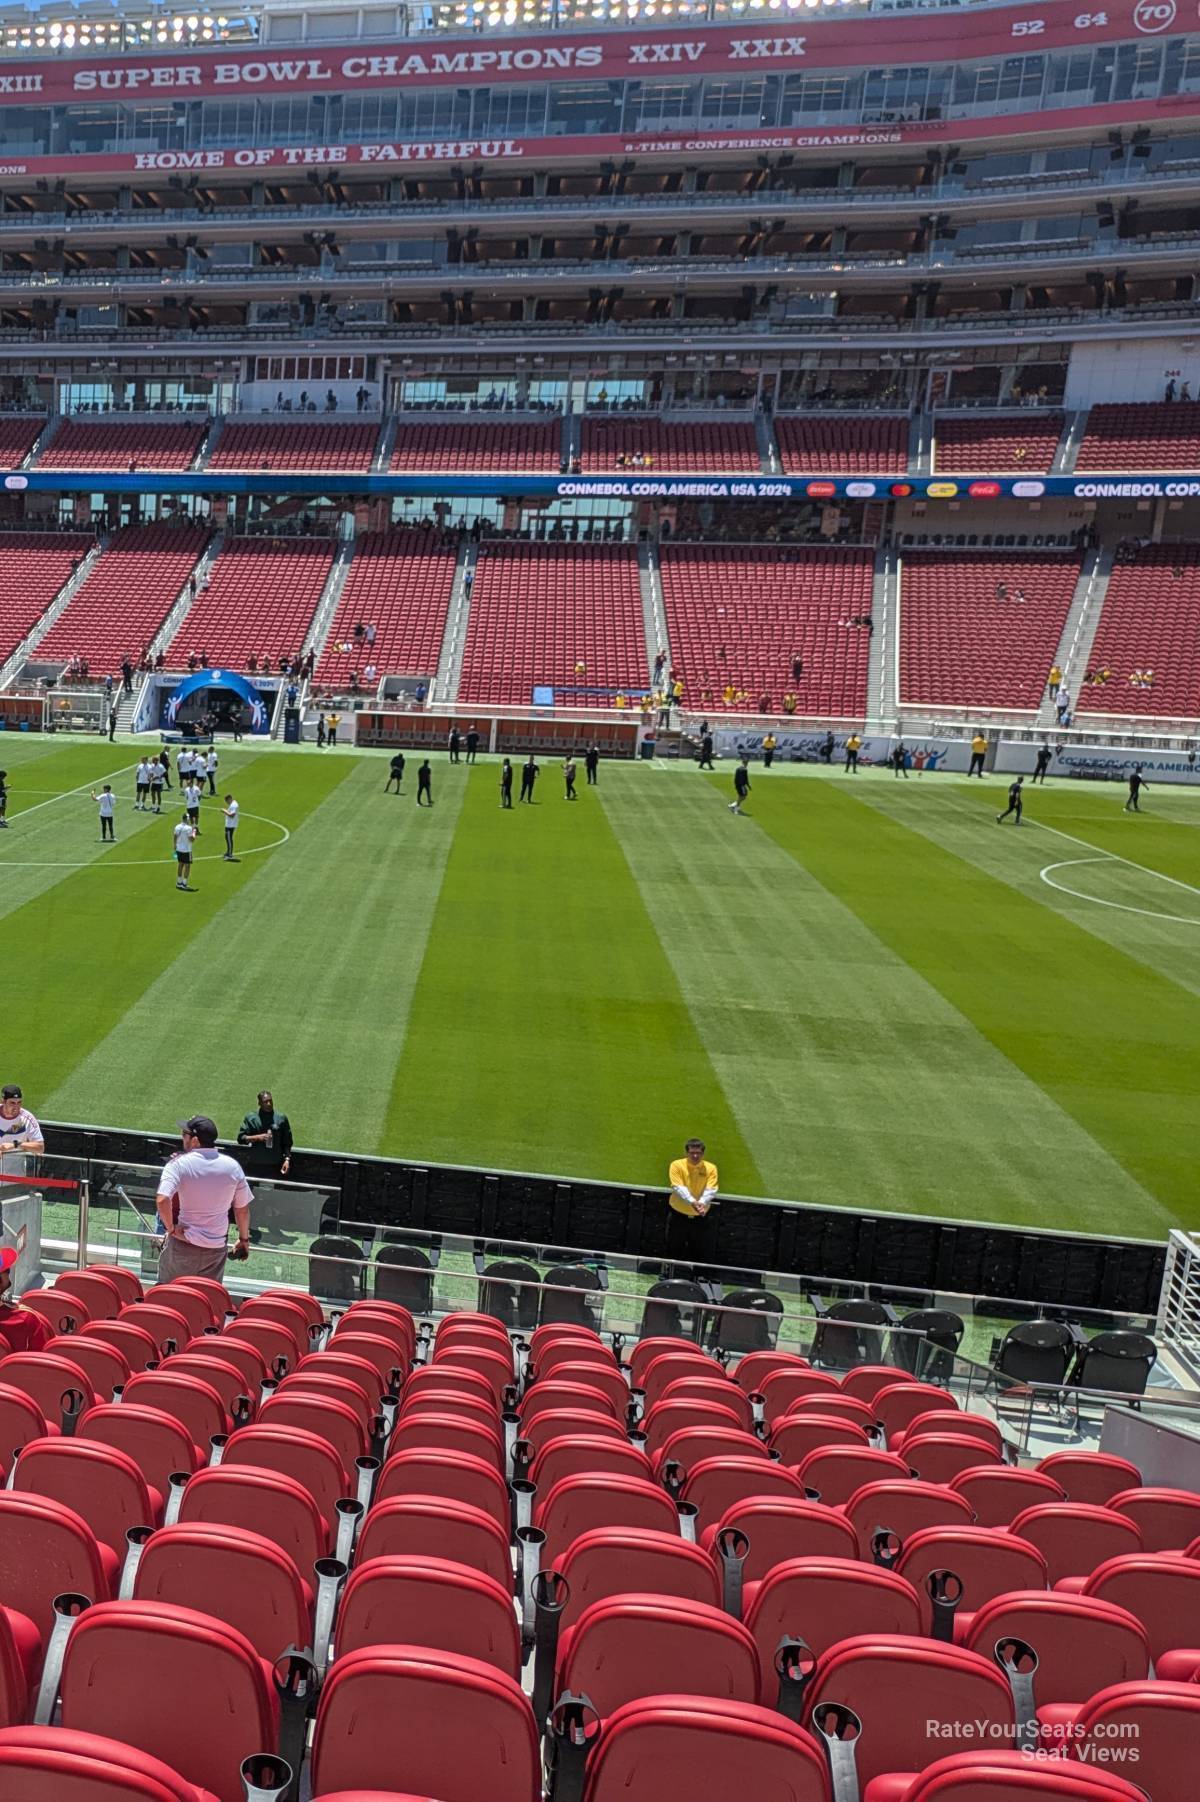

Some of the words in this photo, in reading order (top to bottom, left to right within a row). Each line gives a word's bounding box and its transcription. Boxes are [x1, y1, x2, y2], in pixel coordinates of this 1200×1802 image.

[1074, 12, 1108, 28] 64
[1139, 5, 1171, 20] 70
[1011, 20, 1045, 36] 52
[628, 42, 706, 64] XXIV
[728, 37, 806, 58] XXIX
[73, 66, 202, 90] SUPER
[213, 60, 332, 84] BOWL
[341, 46, 603, 78] CHAMPIONS
[685, 138, 792, 150] CONFERENCE
[796, 133, 902, 146] CHAMPIONS
[134, 151, 224, 170] HOME
[234, 150, 274, 166] OF
[284, 146, 346, 164] THE
[360, 140, 524, 162] FAITHFUL
[558, 482, 630, 495] CONMEBOL
[631, 483, 668, 496] COPA
[668, 484, 728, 496] AMERICA
[730, 484, 756, 496] USA
[758, 484, 792, 496] 2024
[1074, 484, 1163, 496] CONMEBOL
[1124, 760, 1154, 770] COPA
[1156, 762, 1200, 772] AMERIC
